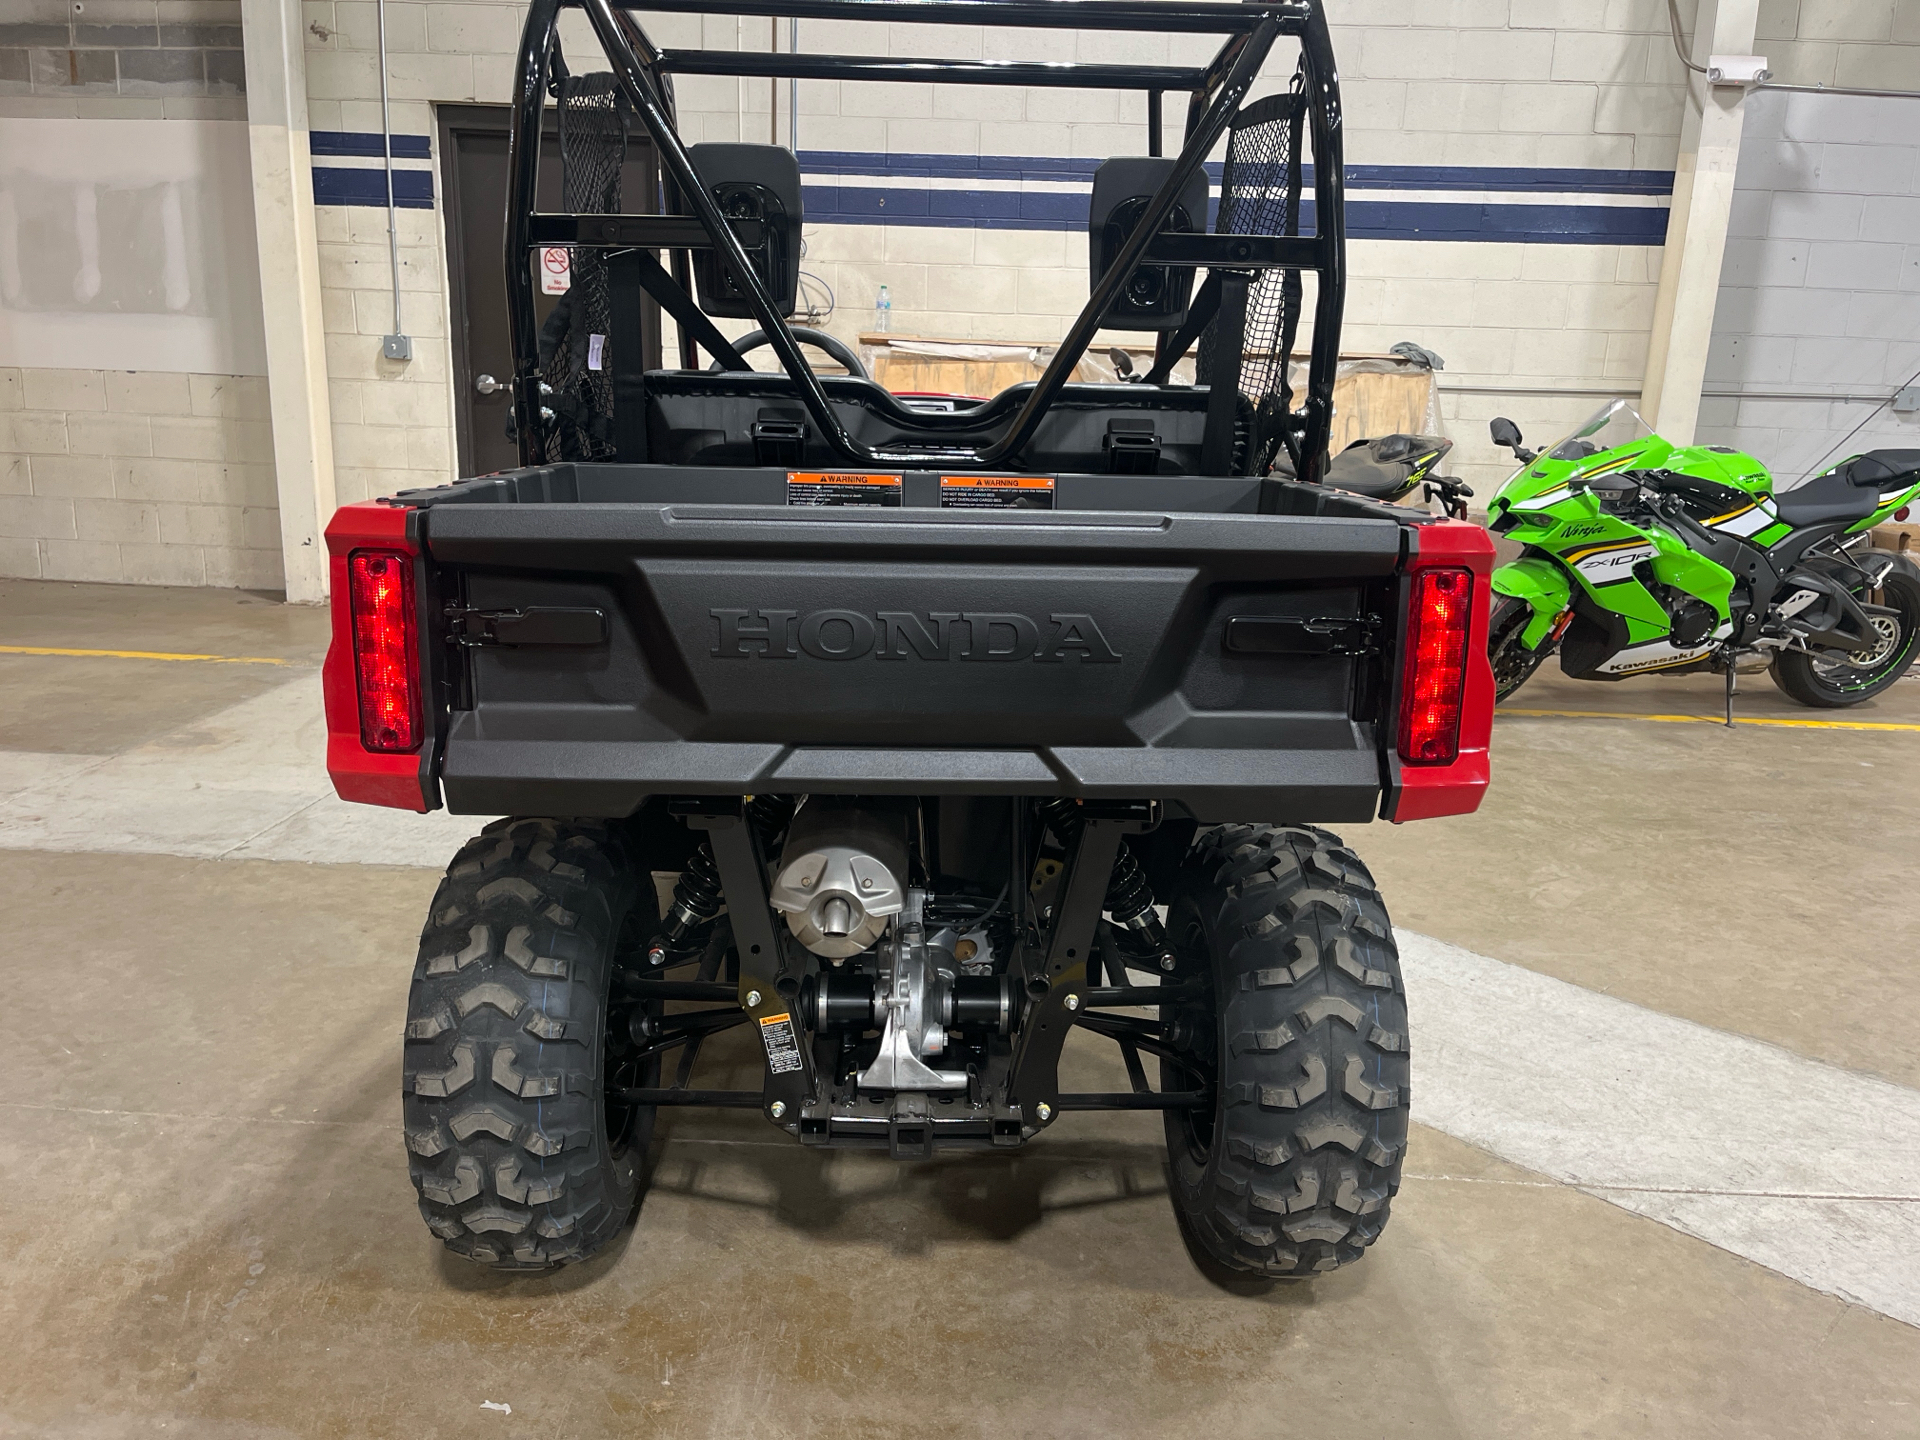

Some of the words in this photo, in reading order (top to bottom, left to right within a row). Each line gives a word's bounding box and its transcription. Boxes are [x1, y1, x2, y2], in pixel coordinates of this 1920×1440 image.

[828, 475, 868, 483] WARNING
[984, 479, 1019, 487] WARNING
[1405, 466, 1427, 487] 765
[1560, 522, 1607, 539] Ninja
[1582, 551, 1652, 570] ZX-10R
[709, 607, 1123, 663] HONDA
[1609, 650, 1695, 671] Kawasaki
